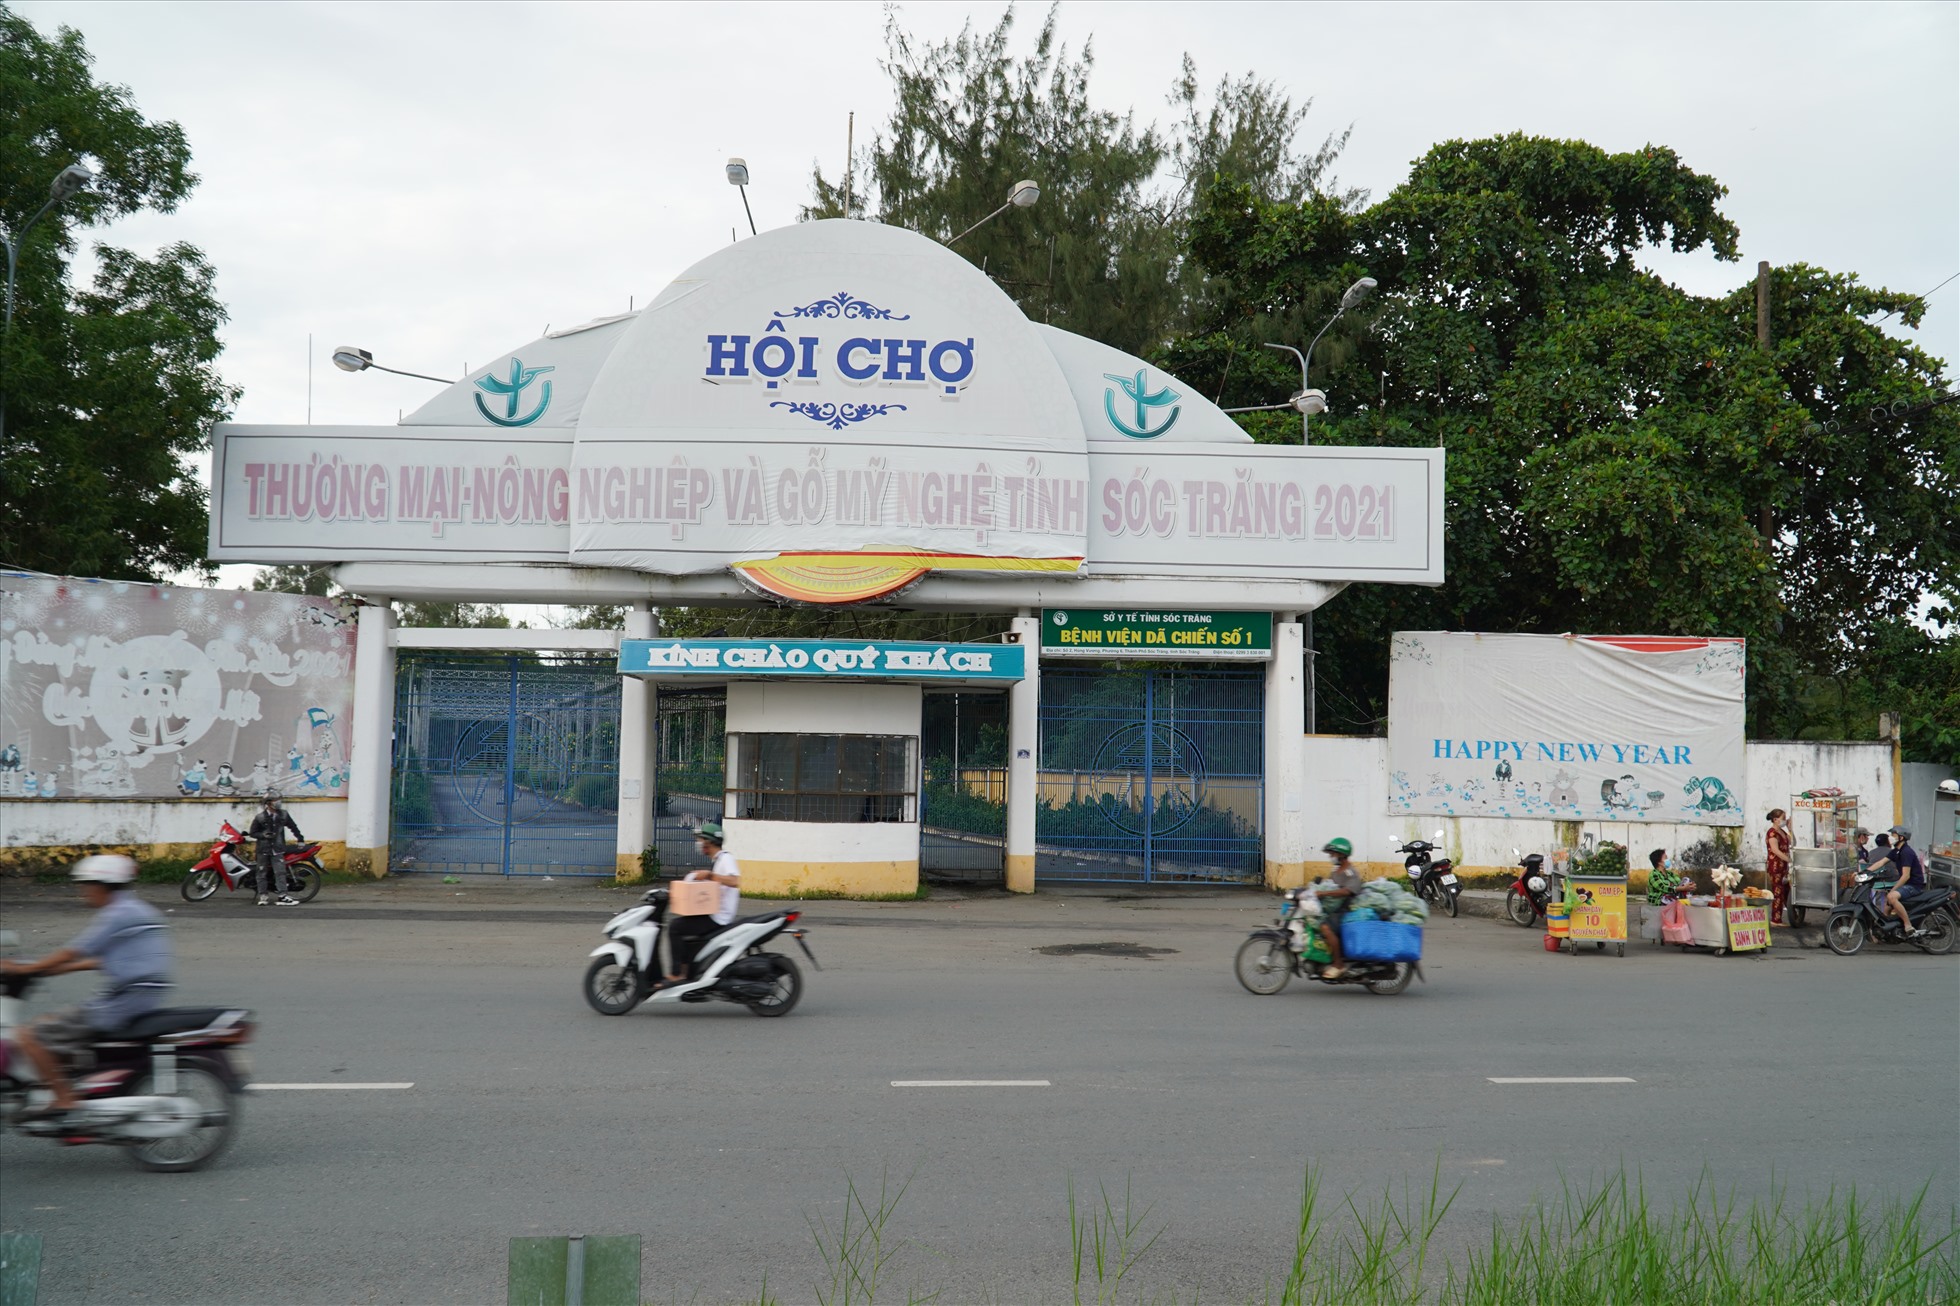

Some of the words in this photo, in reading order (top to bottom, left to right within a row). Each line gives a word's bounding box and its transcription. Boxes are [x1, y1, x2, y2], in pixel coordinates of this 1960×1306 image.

[706, 319, 819, 389] HỘI
[836, 337, 975, 394] CHỢ
[244, 452, 388, 519] THƯƠNG
[577, 455, 712, 537] NGHIỆP
[722, 455, 766, 521] VÀ
[776, 447, 825, 522] GỖ
[835, 456, 888, 522] MỸ
[896, 462, 994, 543] NGHỆ
[1004, 456, 1086, 532] TỈNH
[1102, 466, 1173, 534] SÓC
[1182, 467, 1302, 537] TRĂNG
[1313, 484, 1392, 537] 2021
[1103, 613, 1117, 623] SỞ
[1118, 614, 1125, 622] Y
[1126, 611, 1138, 622] TẾ
[1140, 612, 1160, 623] TỈNH
[1163, 613, 1181, 623] SÓC
[1182, 613, 1212, 624] TRĂNG
[1060, 626, 1101, 646] BỆNH
[1106, 627, 1141, 646] VIỆN
[1146, 628, 1167, 644] DÃ
[1171, 626, 1217, 645] CHIẾN
[1221, 627, 1244, 645] SỐ
[1246, 631, 1252, 645] 1
[648, 643, 720, 667] KÍNH
[723, 643, 809, 669] CHÀO
[812, 645, 880, 671] QUÝ
[884, 647, 993, 672] KHÁCH
[1432, 738, 1530, 761] HAPPY
[1537, 741, 1604, 763] NEW
[1611, 744, 1693, 765] YEAR
[1586, 914, 1600, 926] 10
